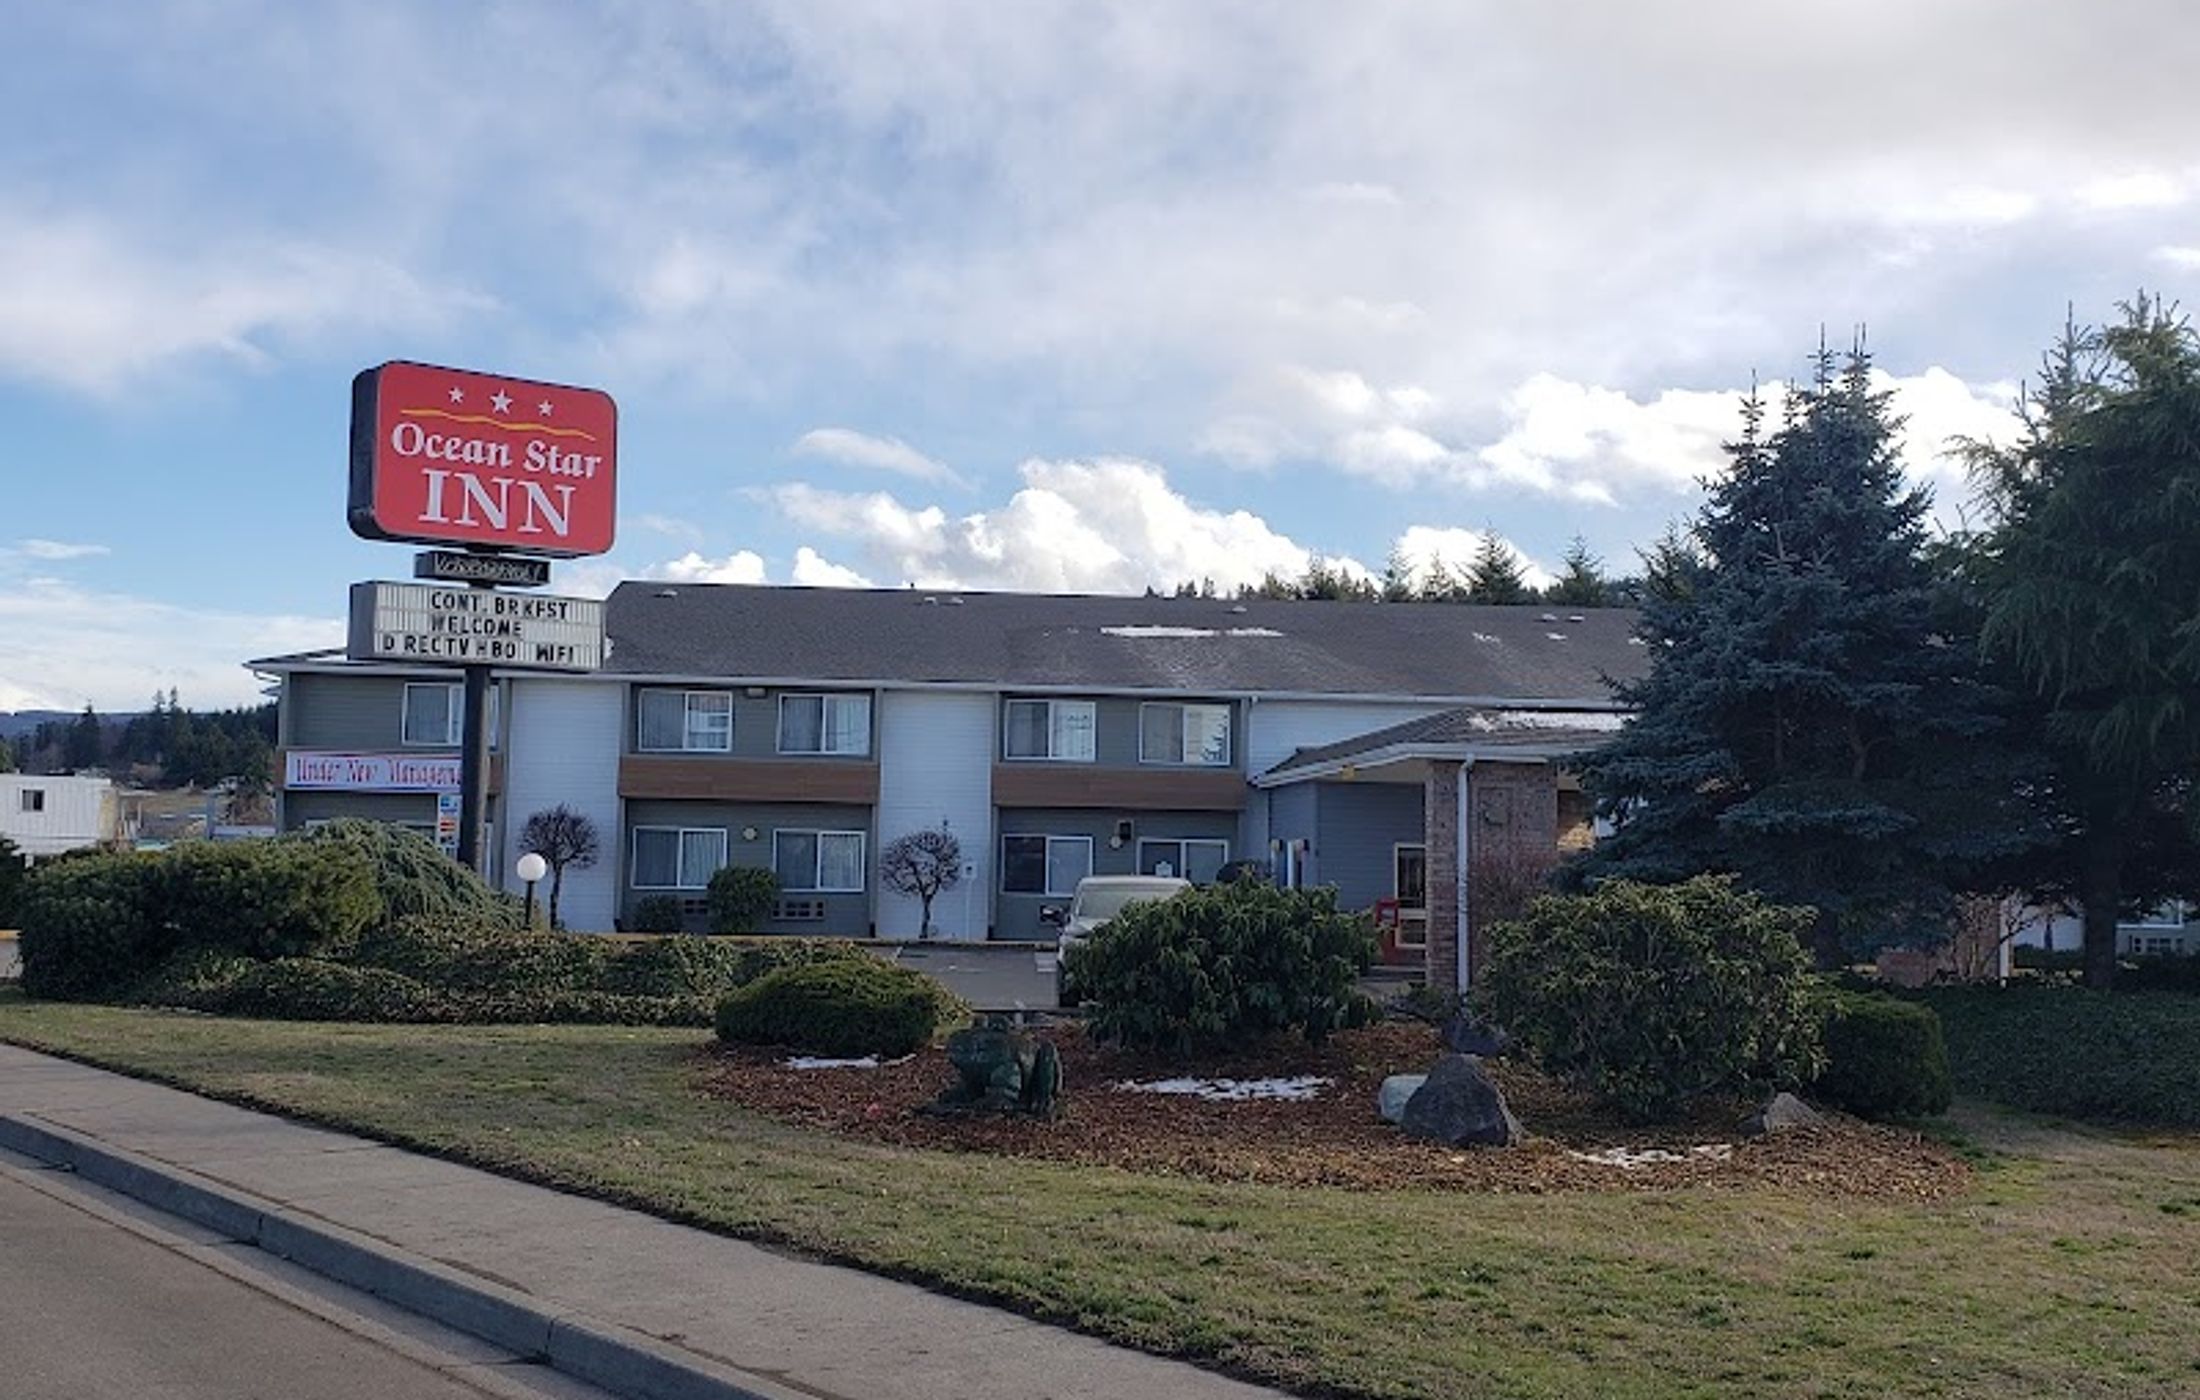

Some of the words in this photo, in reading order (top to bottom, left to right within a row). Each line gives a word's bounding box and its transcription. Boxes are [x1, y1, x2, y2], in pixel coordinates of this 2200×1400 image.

[391, 422, 513, 468] Ocean
[522, 439, 602, 479] Star
[417, 467, 576, 537] INN
[495, 597, 569, 620] BRKFST
[431, 615, 523, 637] WELCOME
[536, 645, 575, 663] WIFI
[296, 758, 340, 783] Under
